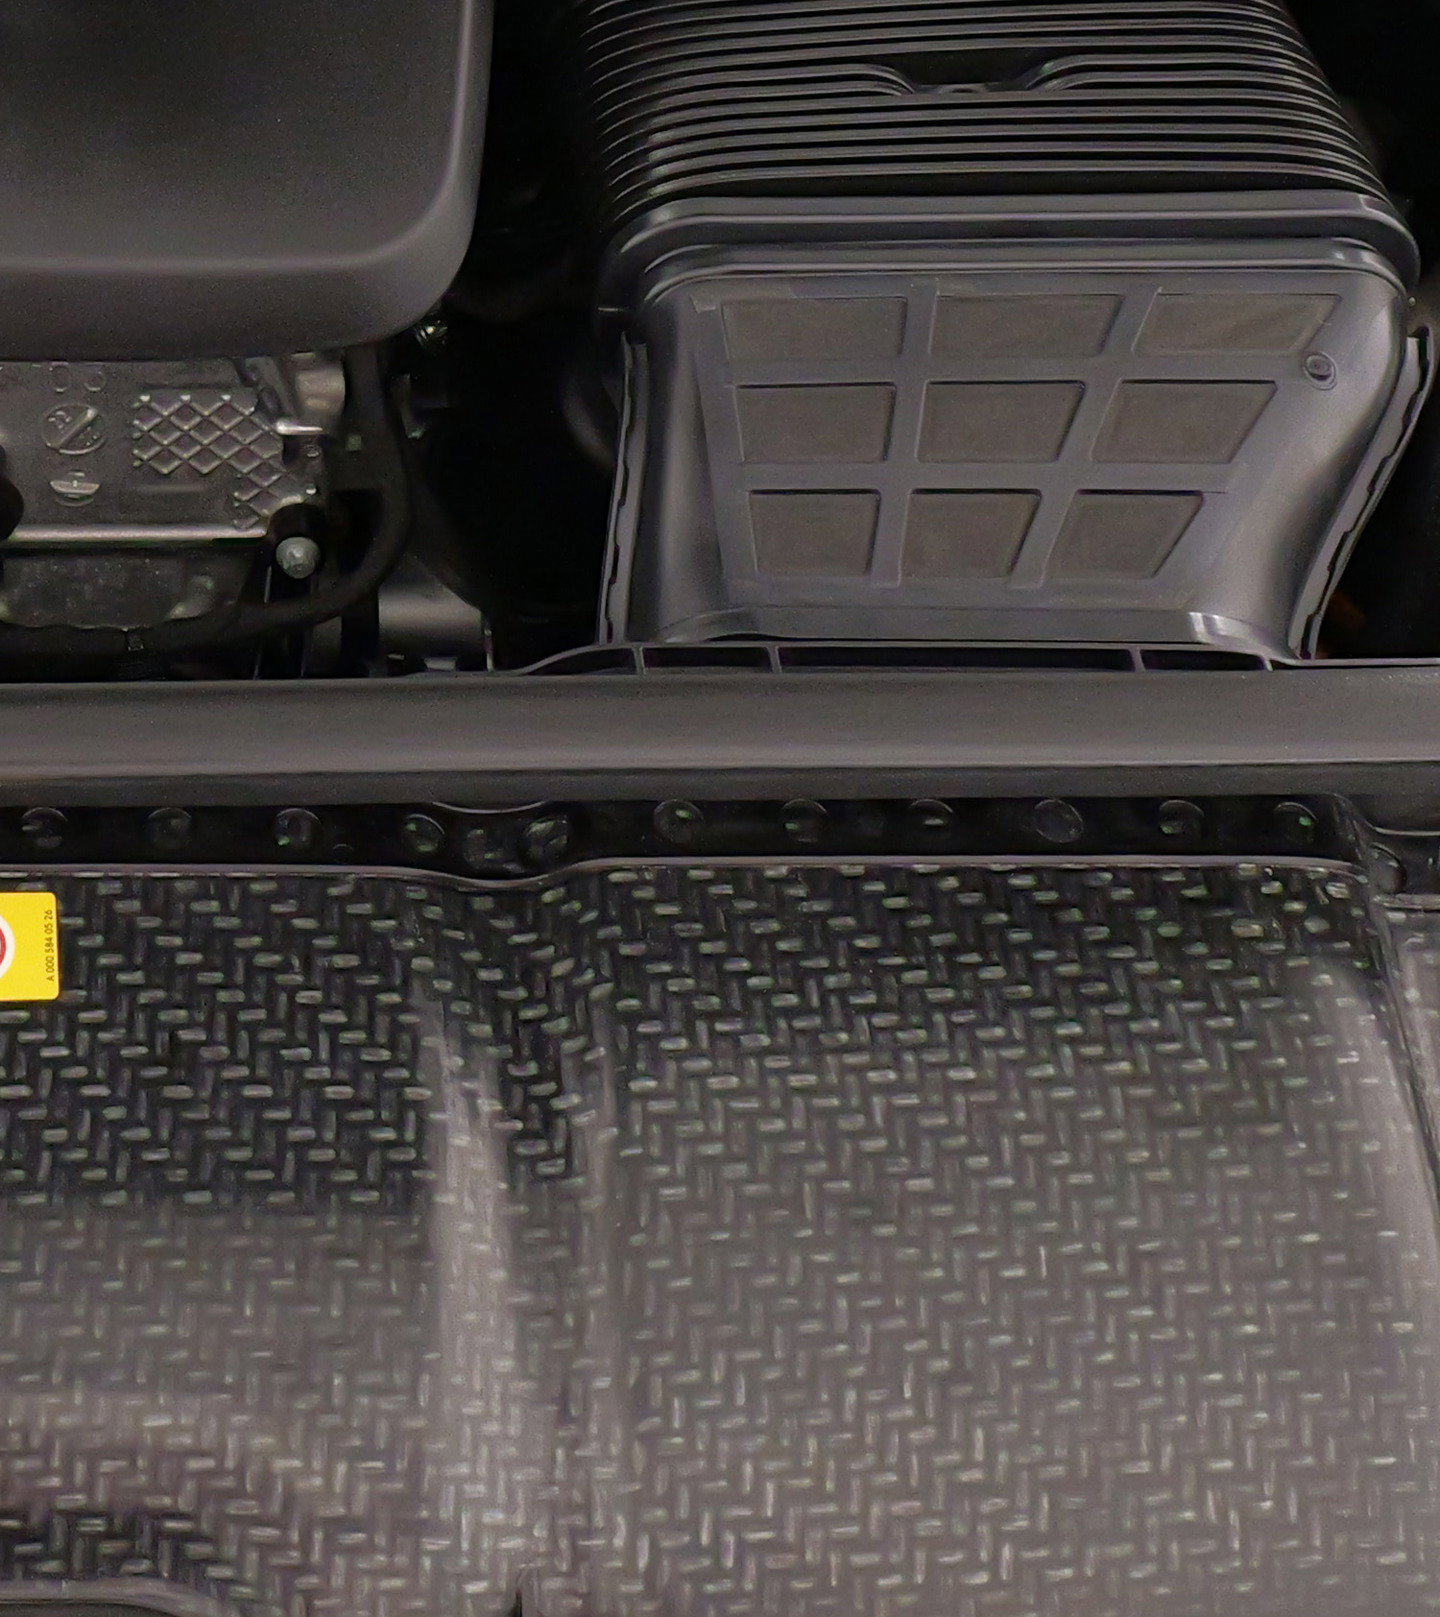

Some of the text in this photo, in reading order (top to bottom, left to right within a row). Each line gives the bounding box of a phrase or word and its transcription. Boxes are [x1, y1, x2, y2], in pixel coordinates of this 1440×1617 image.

[43, 909, 55, 982] A 000 584 05 26
